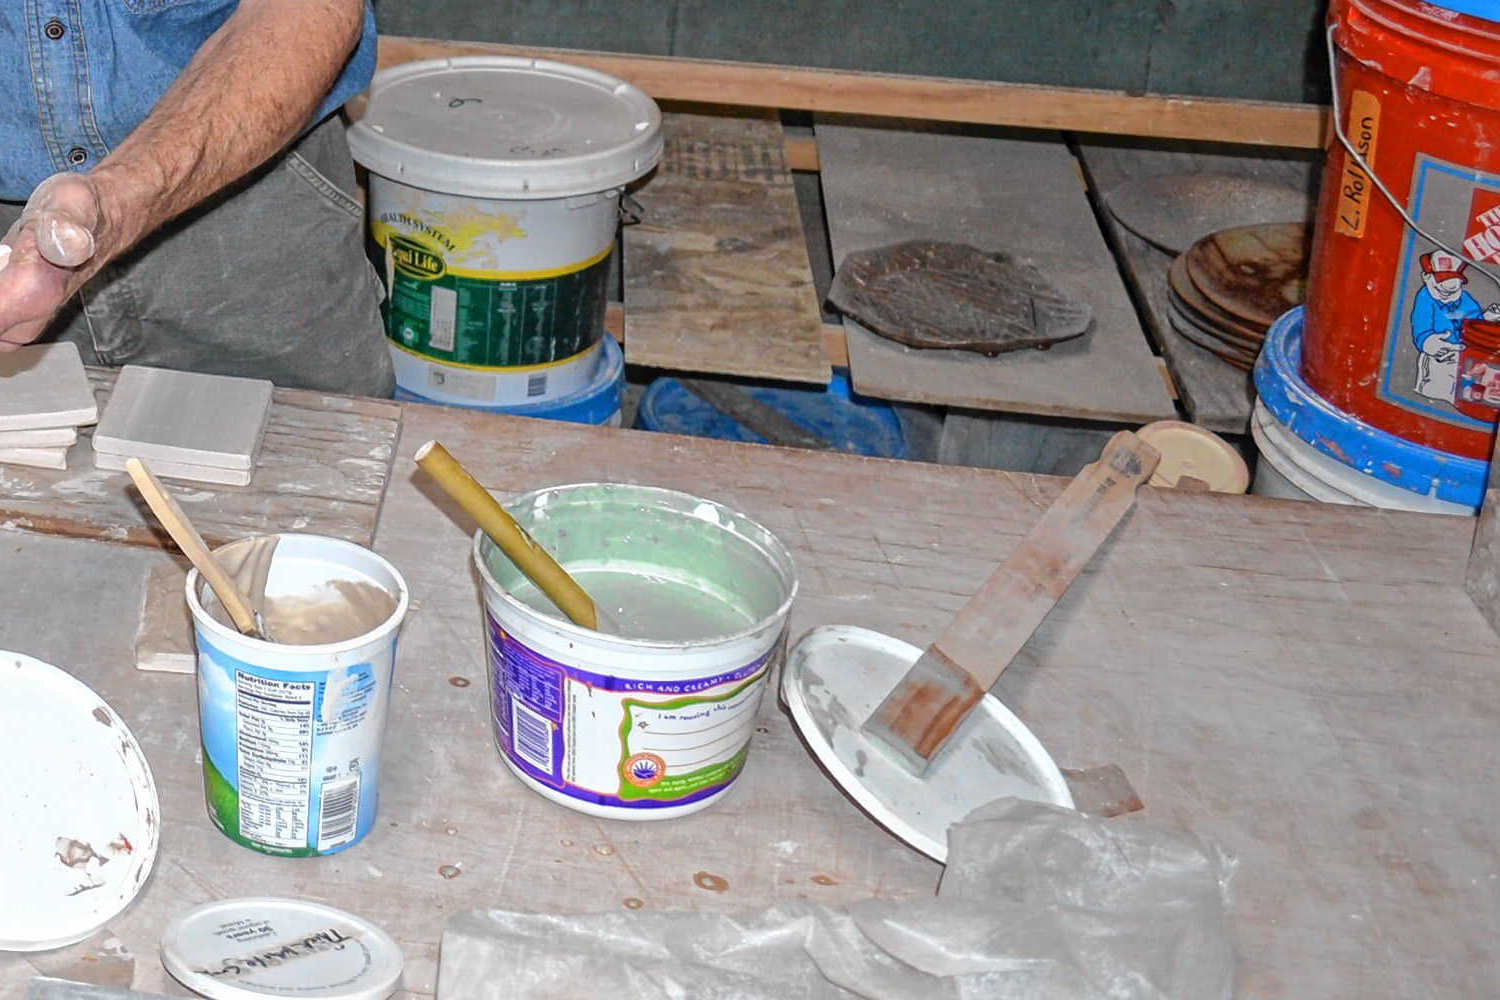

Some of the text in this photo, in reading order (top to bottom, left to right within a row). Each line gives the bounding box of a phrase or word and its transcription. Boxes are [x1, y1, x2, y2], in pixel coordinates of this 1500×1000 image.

[1340, 209, 1361, 232] L.
[414, 250, 440, 273] Life
[237, 671, 311, 691] Nutrition Facts
[623, 682, 651, 692] RICH
[656, 682, 682, 693] AND
[682, 674, 723, 692] CREAMY
[678, 709, 711, 721] reusing
[712, 703, 727, 712] this
[226, 928, 257, 940] years
